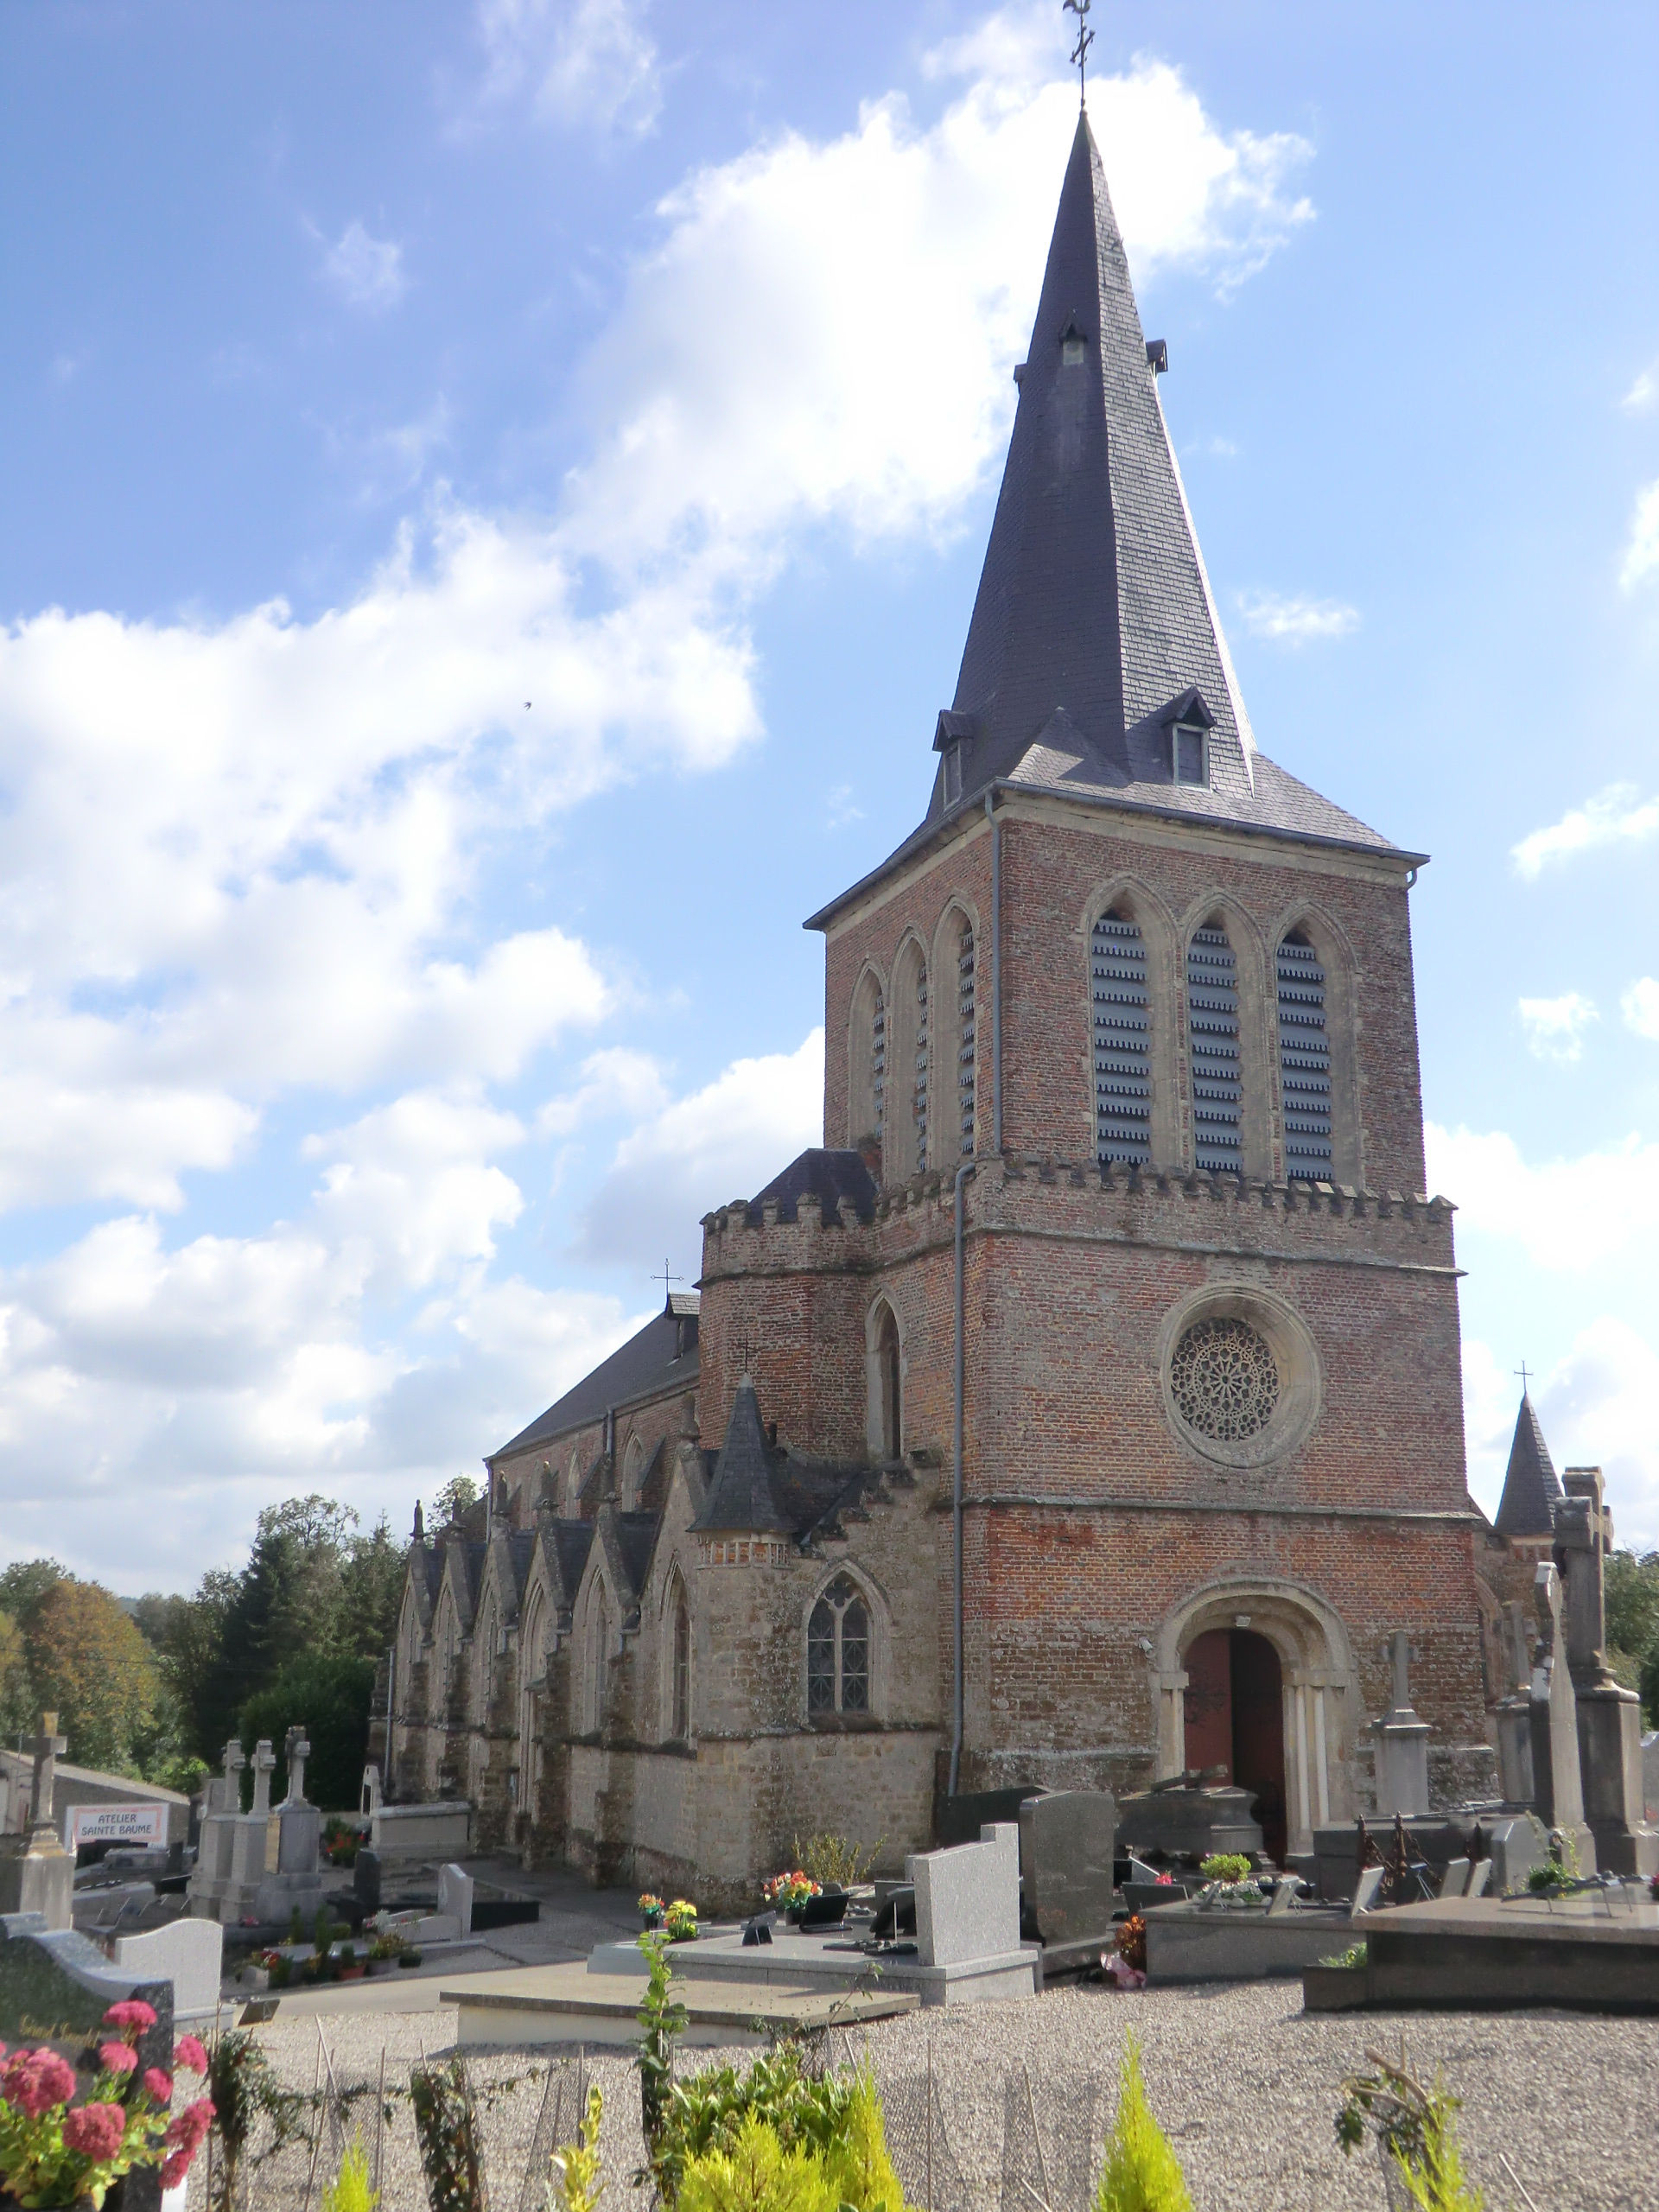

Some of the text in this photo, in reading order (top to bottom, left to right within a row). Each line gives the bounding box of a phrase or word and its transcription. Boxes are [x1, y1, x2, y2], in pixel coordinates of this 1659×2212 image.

[99, 1814, 137, 1823] ATELIER
[81, 1824, 152, 1835] SAINTE BAUME
